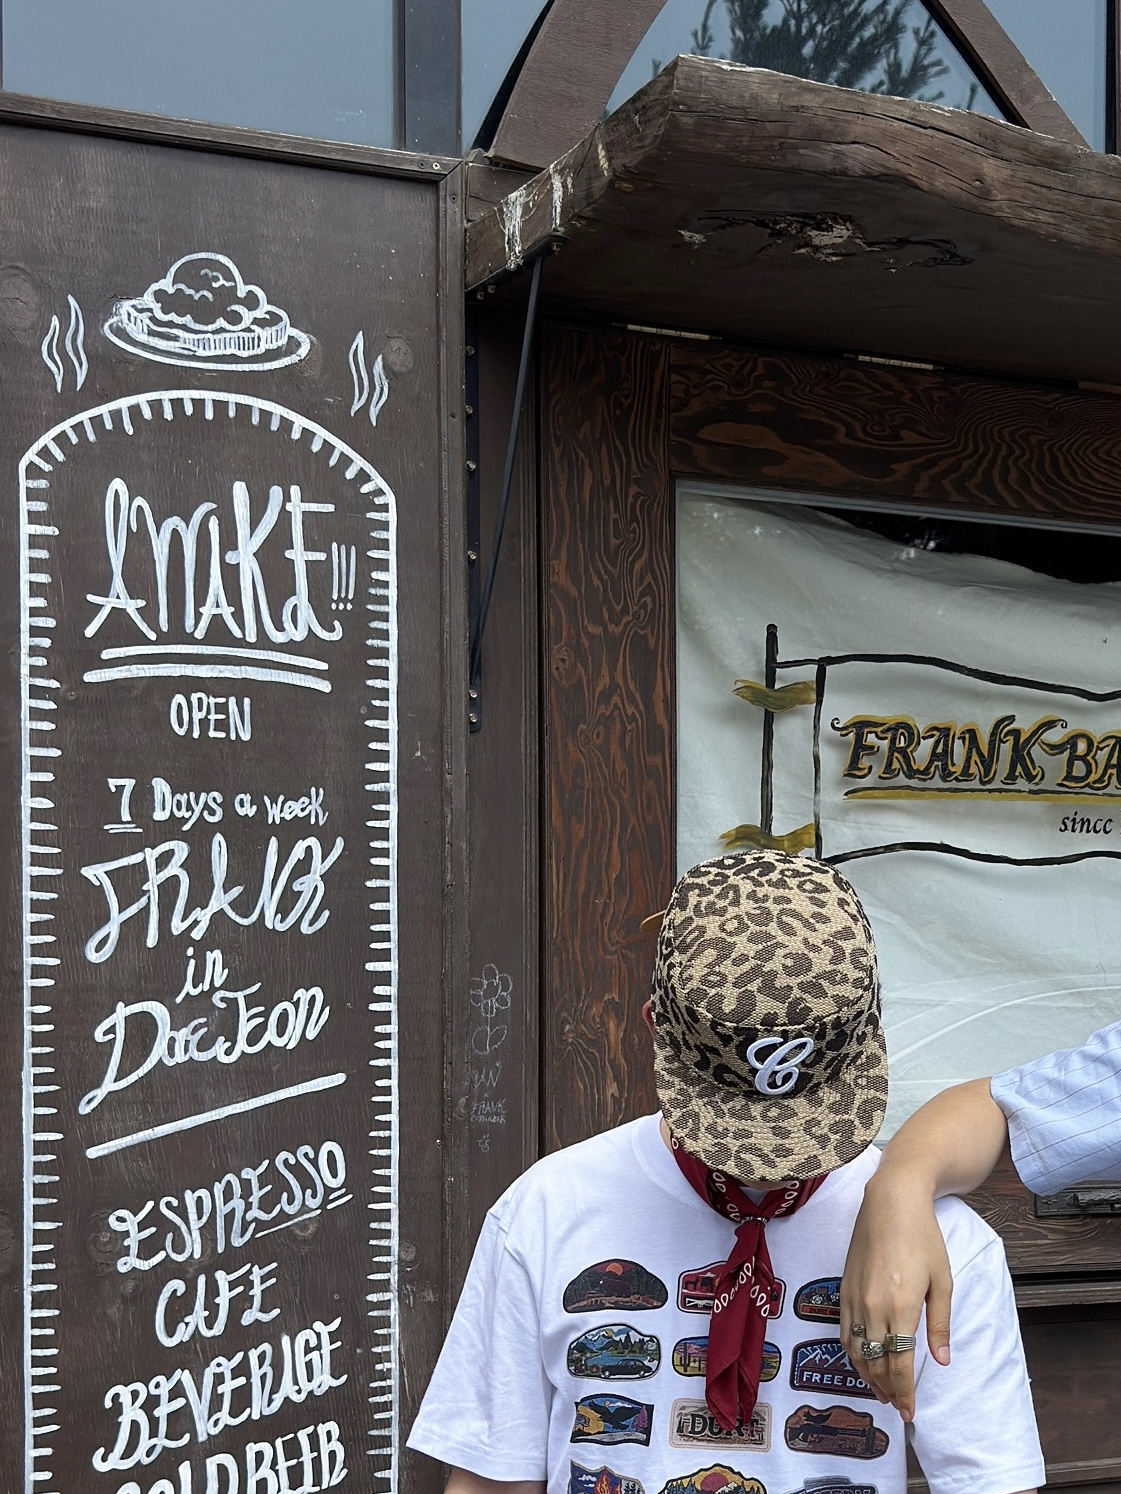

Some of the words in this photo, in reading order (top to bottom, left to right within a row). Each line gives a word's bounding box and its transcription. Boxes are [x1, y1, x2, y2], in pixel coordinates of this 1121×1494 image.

[170, 693, 252, 741] OPEN
[831, 714, 1067, 785] FRANK
[107, 778, 136, 822] 7
[153, 777, 223, 830] Days
[235, 797, 257, 818] a
[81, 833, 345, 963] FRANK
[176, 947, 229, 1003] in
[107, 1140, 346, 1273] ESPRESSO
[155, 1262, 281, 1347] CAFE
[92, 1316, 348, 1472] BEVERAGE
